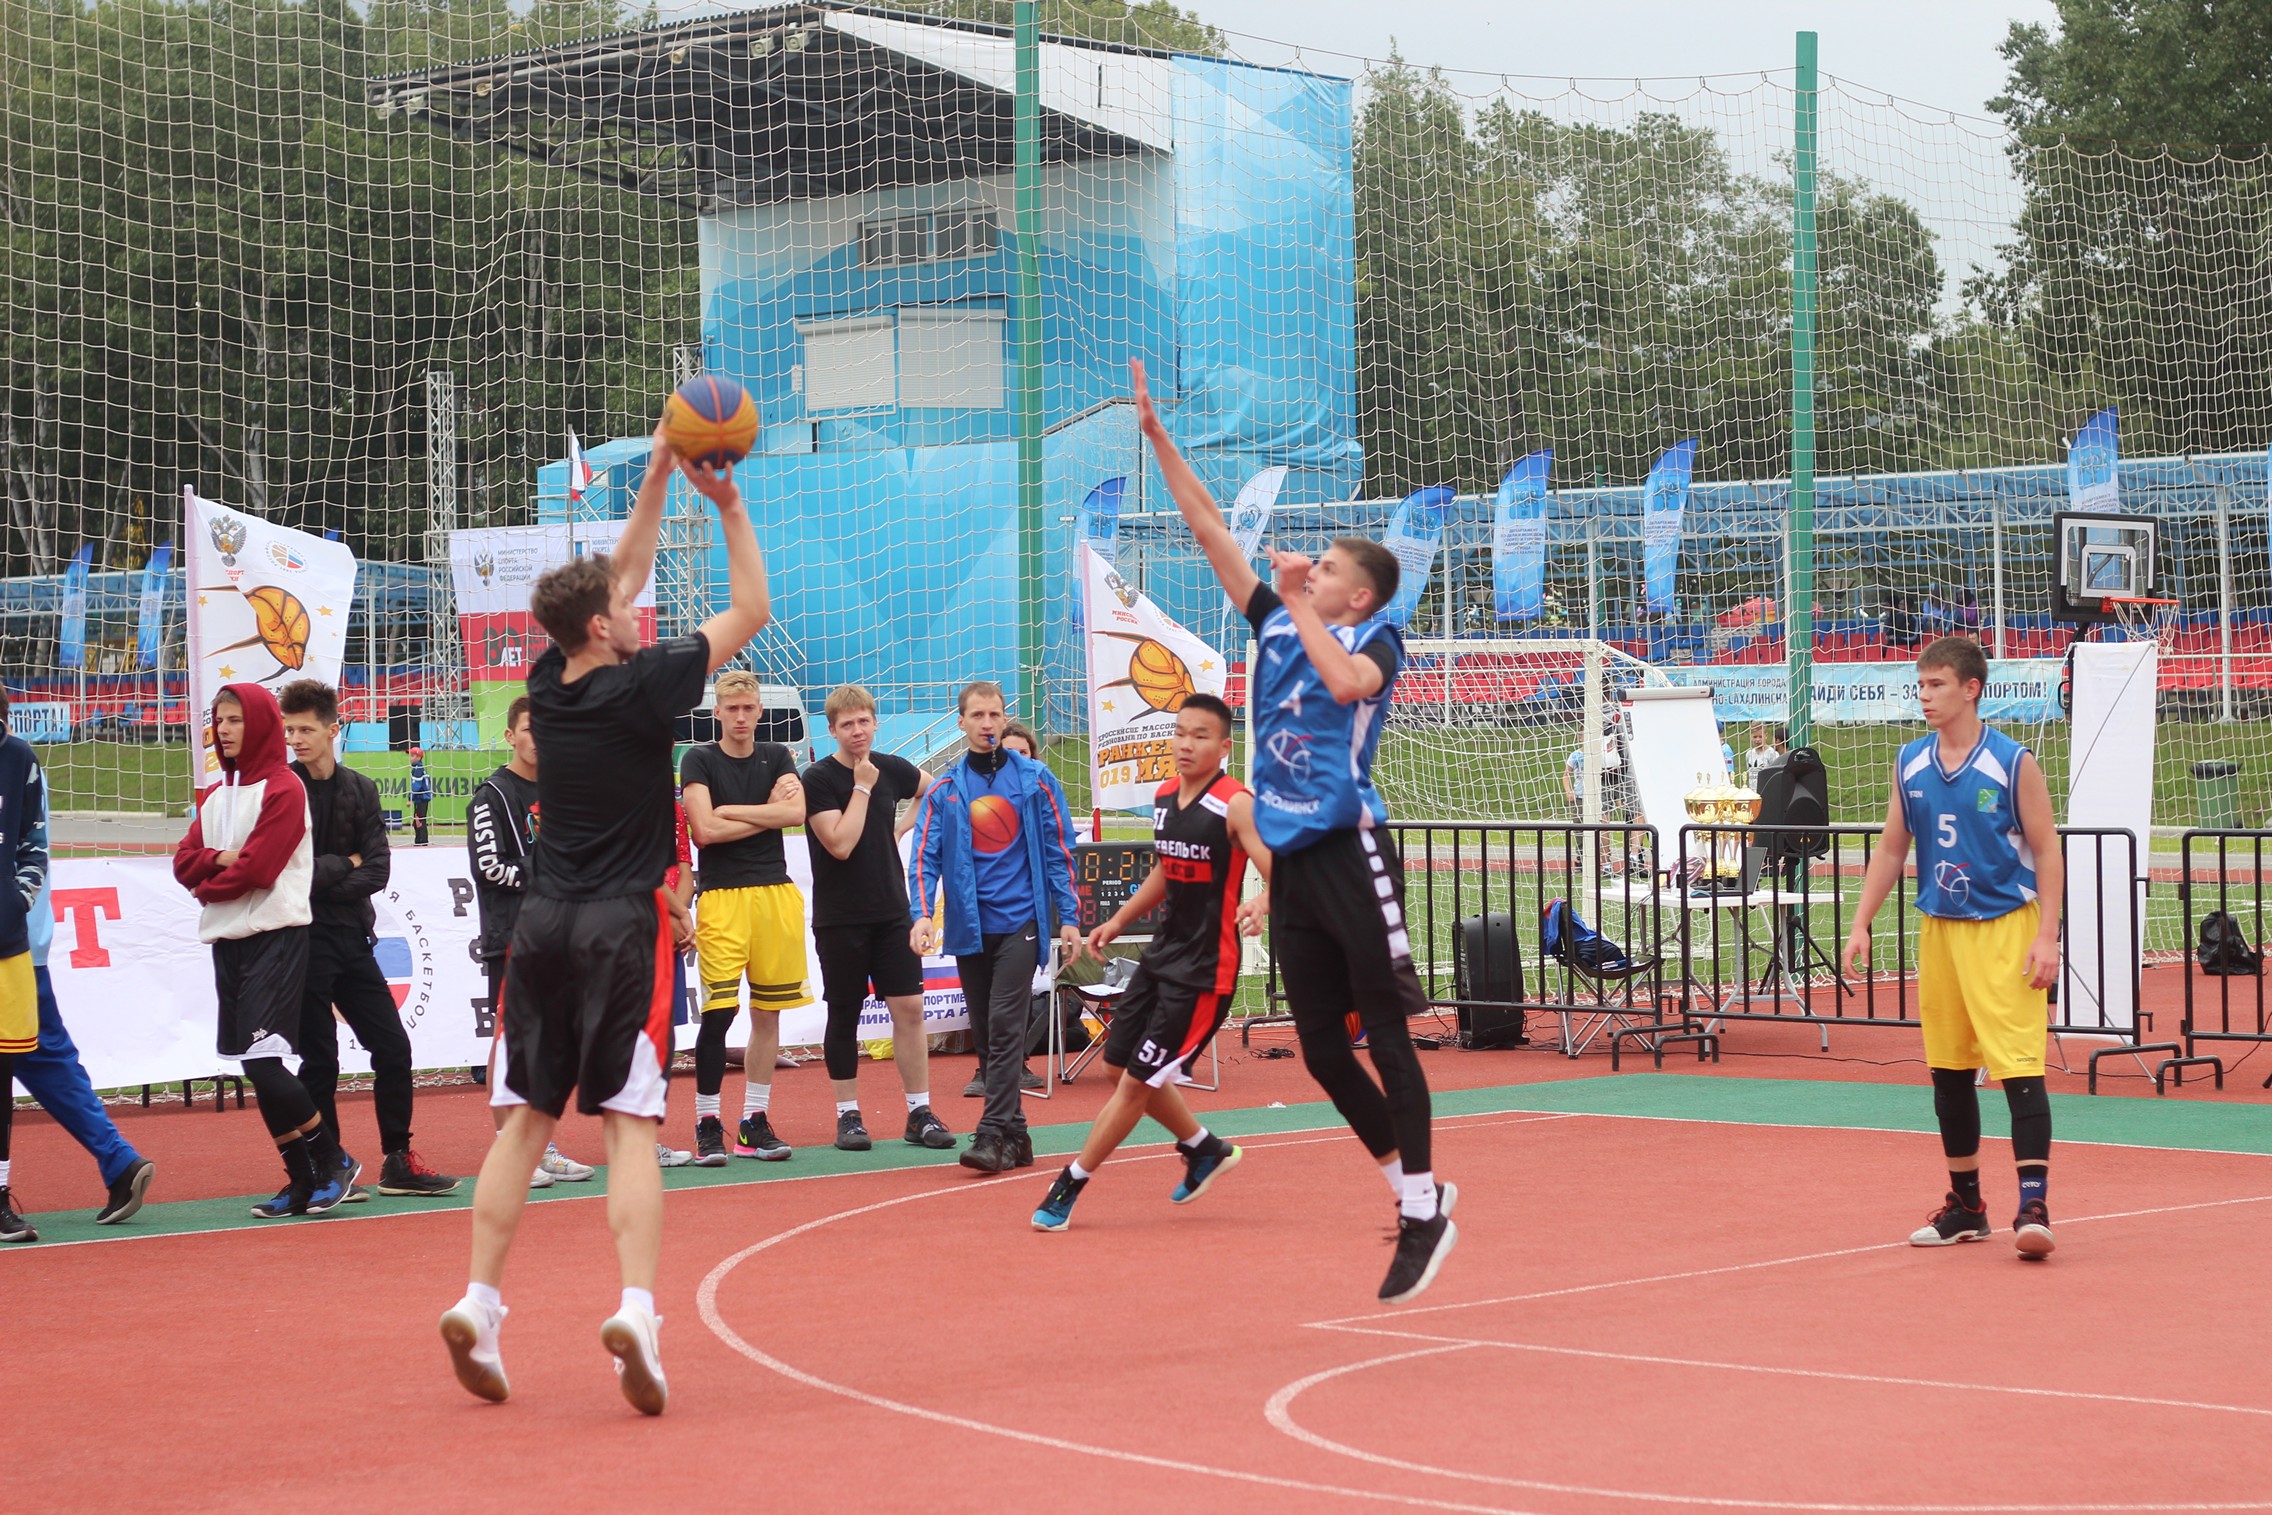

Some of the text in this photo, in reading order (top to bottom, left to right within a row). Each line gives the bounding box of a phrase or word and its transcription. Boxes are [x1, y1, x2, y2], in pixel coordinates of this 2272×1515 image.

[500, 647, 522, 667] ЛЕТ
[1693, 679, 1755, 688] АДМИНИСТРАЦИЯ
[1810, 682, 1845, 703] АЙДИ
[1850, 684, 1885, 700] СЕБЯ
[1984, 681, 2047, 700] ПОРТОМ!
[1712, 693, 1788, 705] НО-САХАЛИНСКА
[377, 777, 407, 798] ОРМ
[1100, 766, 1131, 788] 019
[1938, 813, 1958, 848] 5
[1155, 840, 1211, 860] ЕВЕЛЬСК
[50, 887, 121, 969] Т
[1138, 1039, 1168, 1067] 51
